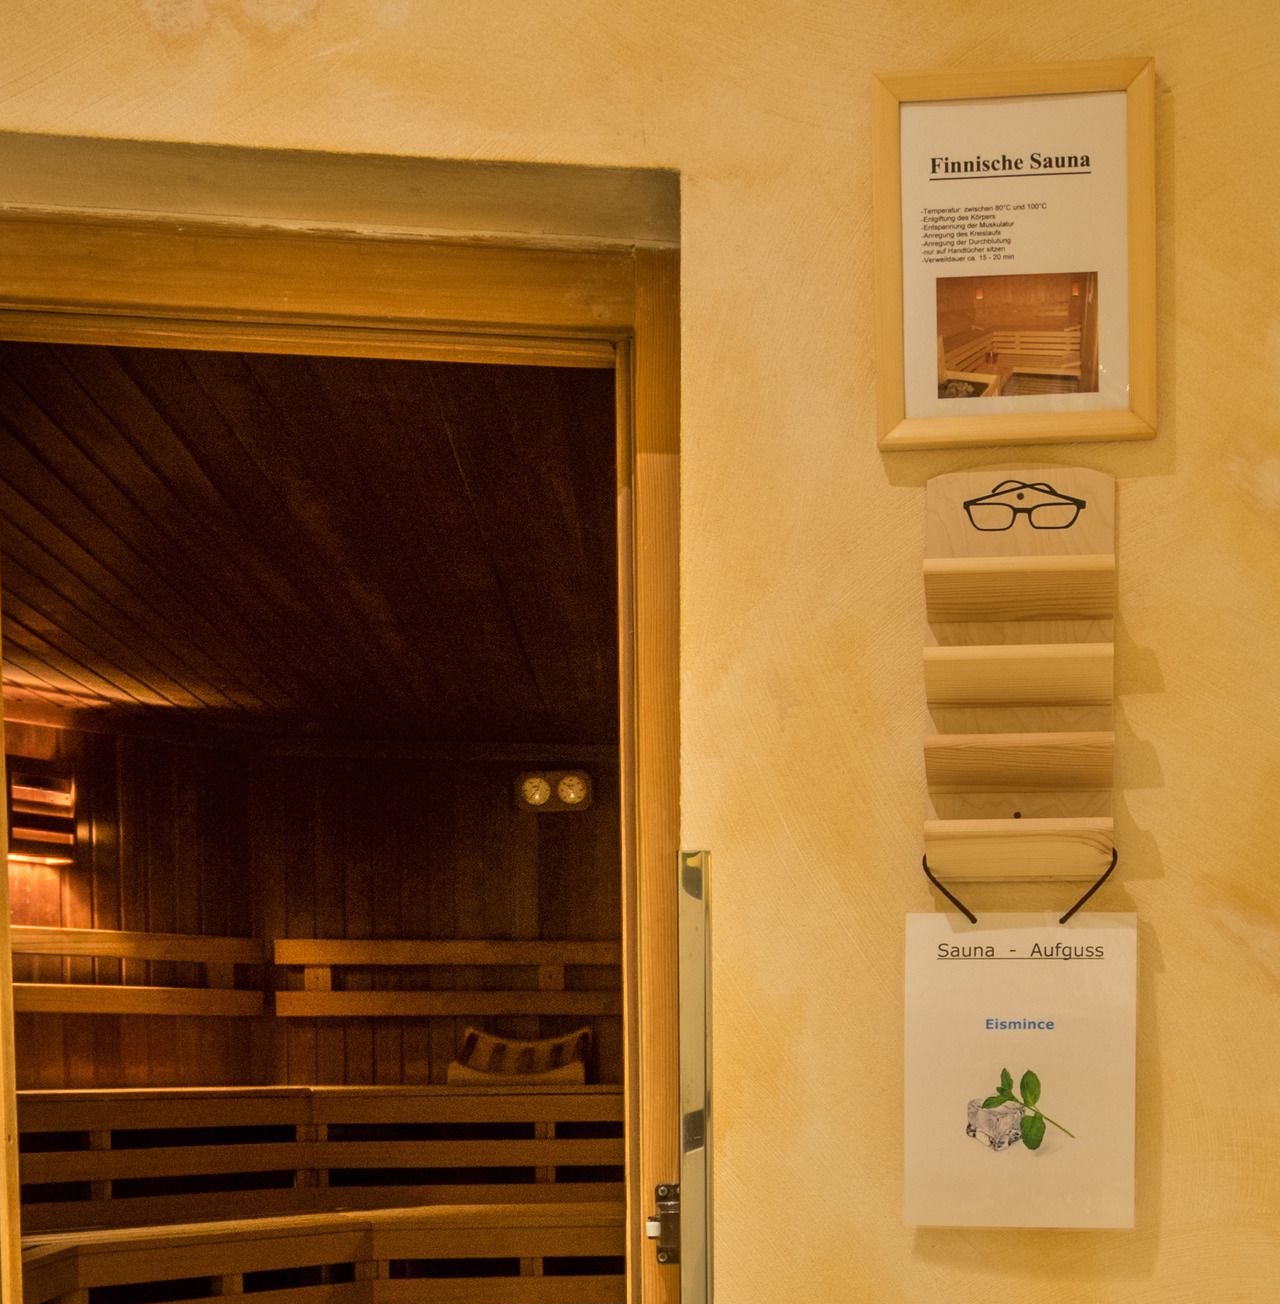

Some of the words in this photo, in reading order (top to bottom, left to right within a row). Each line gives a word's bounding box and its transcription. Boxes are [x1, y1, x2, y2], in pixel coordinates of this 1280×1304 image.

[930, 154, 1024, 174] Finnische
[1030, 152, 1091, 170] Sauna
[1013, 203, 1025, 211] und
[956, 230, 968, 238] des
[968, 237, 1012, 246] Durchblutung
[992, 253, 1001, 261] 20
[937, 943, 995, 958] Sauna
[1030, 942, 1104, 961] Aufguss
[985, 1018, 1055, 1031] Eismince
